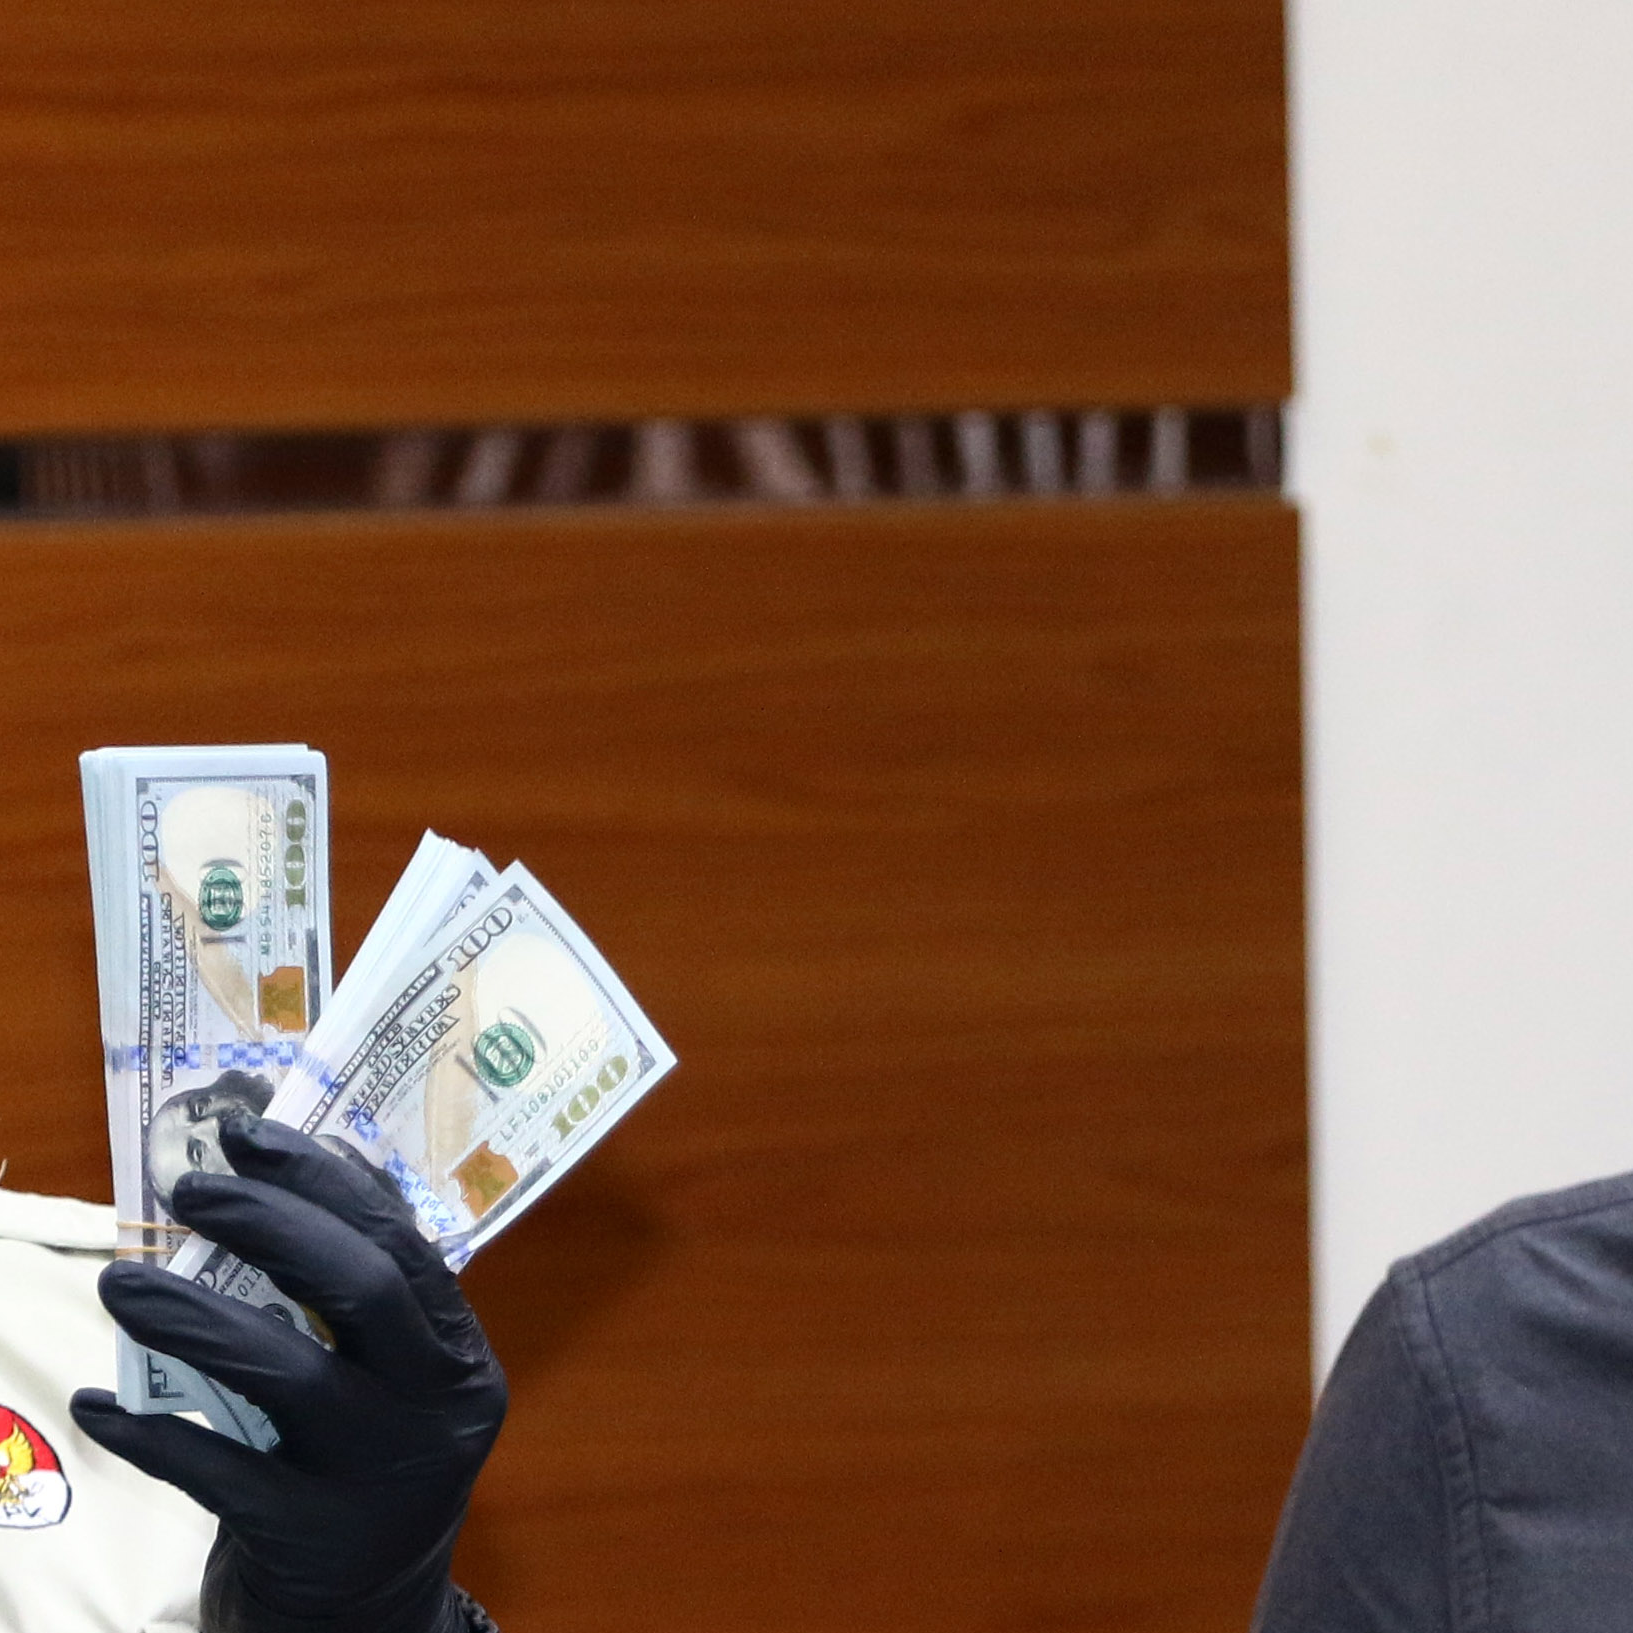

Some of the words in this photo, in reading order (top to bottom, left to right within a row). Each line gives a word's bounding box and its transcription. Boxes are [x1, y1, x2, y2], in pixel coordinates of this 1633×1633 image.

[140, 800, 159, 882] 100
[285, 800, 306, 910] 100
[448, 908, 513, 972] 100
[550, 1056, 628, 1143] 100
